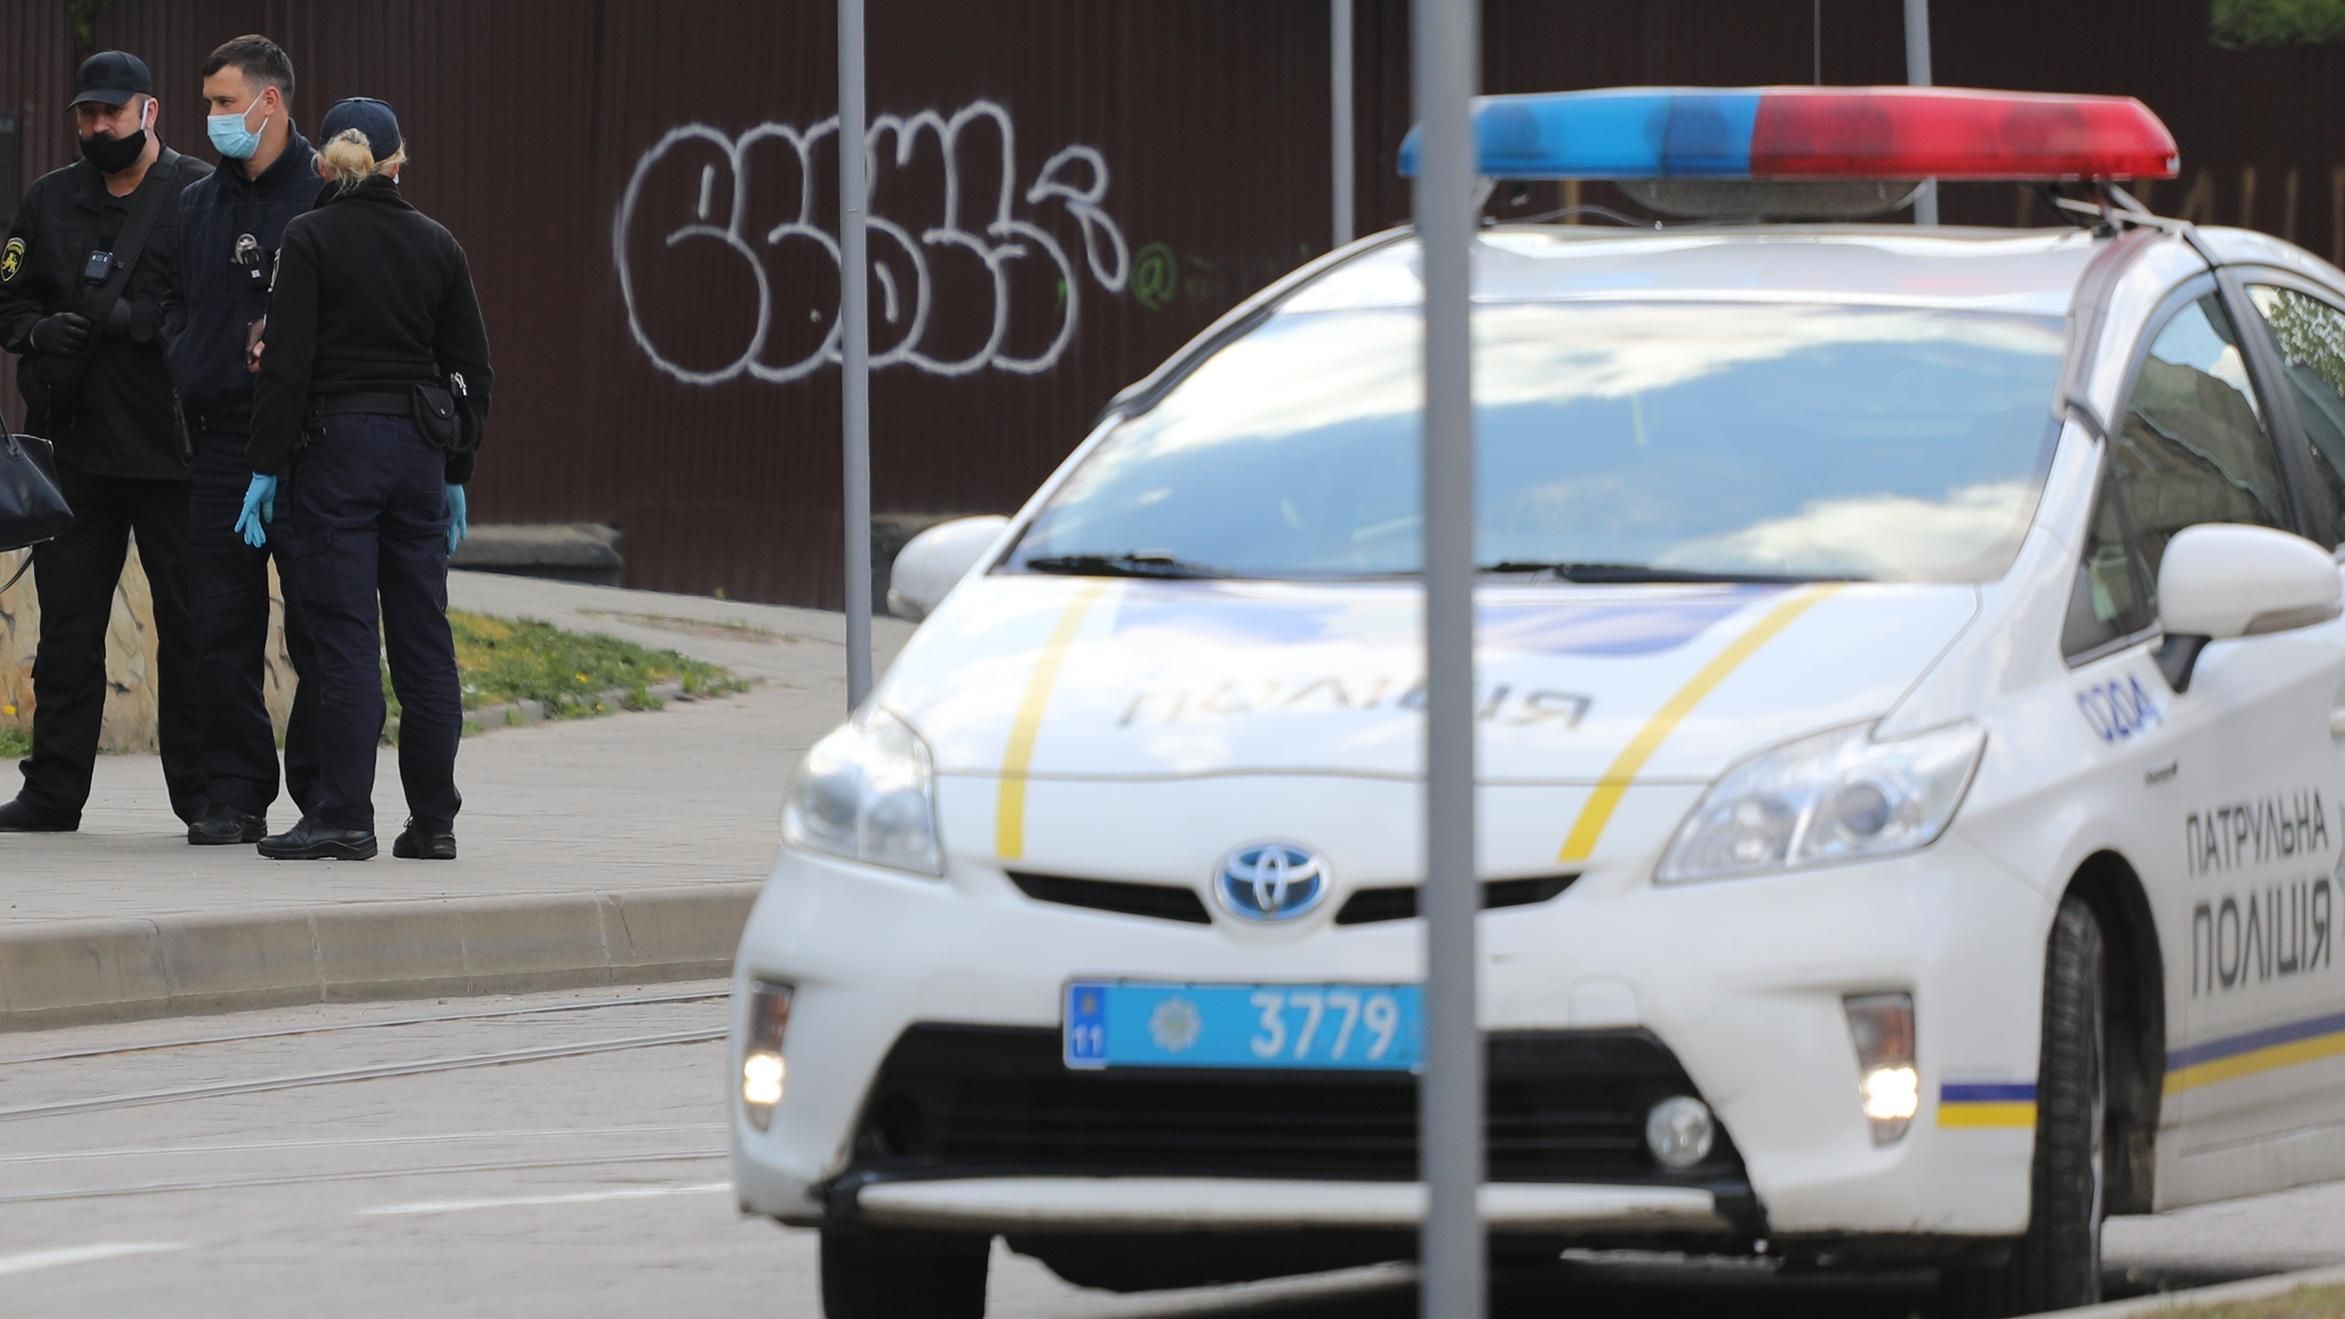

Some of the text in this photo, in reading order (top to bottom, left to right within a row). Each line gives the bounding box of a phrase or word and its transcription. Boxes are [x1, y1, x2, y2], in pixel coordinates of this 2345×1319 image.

[2186, 786, 2330, 877] ПАТРУЛЬНА
[2193, 878, 2332, 999] ПОЛІЦІЯ
[1249, 992, 1399, 1060] 3779
